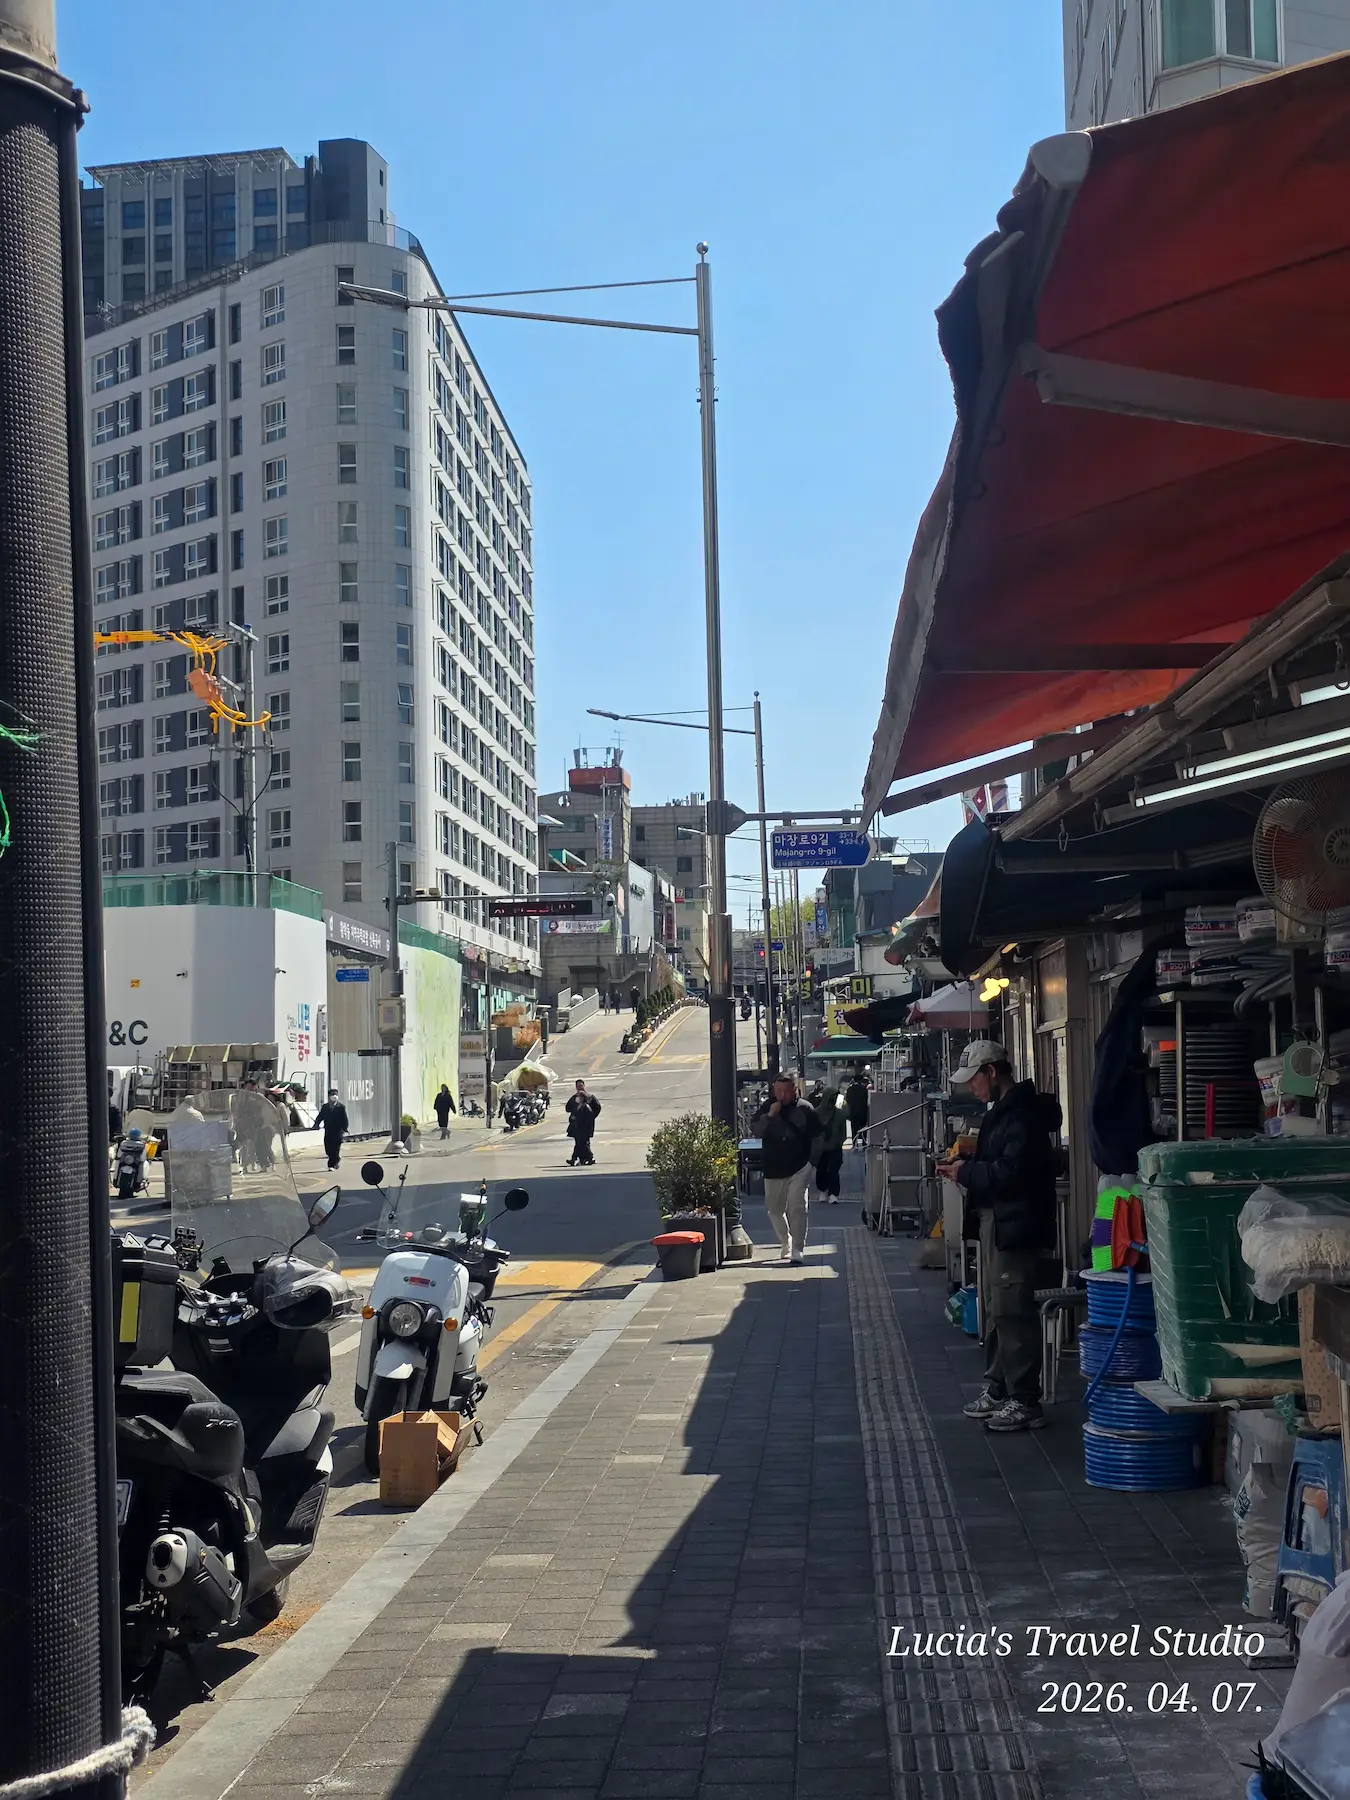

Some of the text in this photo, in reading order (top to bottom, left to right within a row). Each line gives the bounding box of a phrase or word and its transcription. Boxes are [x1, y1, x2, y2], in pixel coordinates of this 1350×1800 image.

[774, 833, 829, 847] 마장로9길
[775, 846, 837, 857] Majang-ro 9-gil
[108, 1020, 149, 1047] &C
